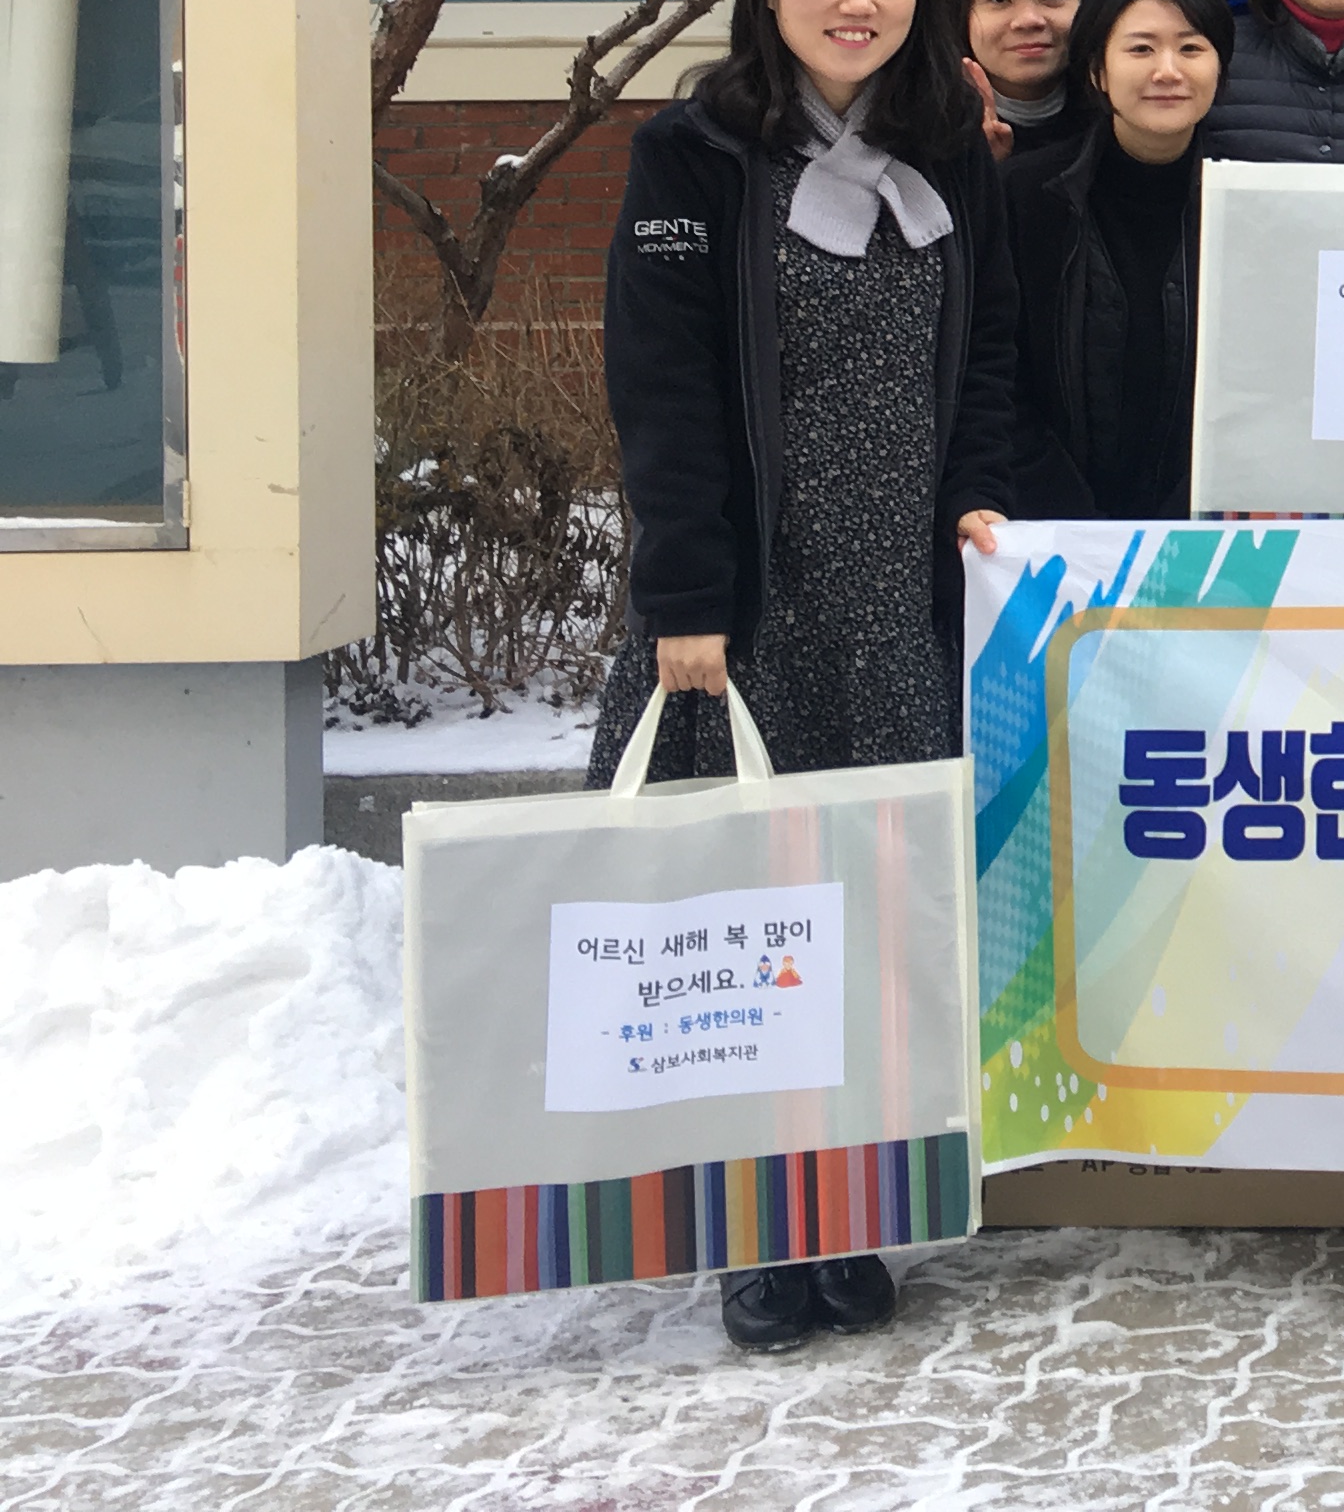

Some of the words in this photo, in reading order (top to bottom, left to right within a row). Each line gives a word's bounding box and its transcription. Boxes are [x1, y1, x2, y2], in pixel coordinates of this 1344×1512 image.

[634, 218, 708, 236] GENTE
[577, 937, 645, 965] 어르신
[661, 928, 708, 957] 새해
[724, 924, 748, 949] 복
[764, 919, 812, 948] 많이
[638, 968, 745, 1008] 받으세요.
[619, 1023, 653, 1043] 후원
[678, 1008, 764, 1035] 동생한의원
[651, 1044, 758, 1074] 삼보사회복지관
